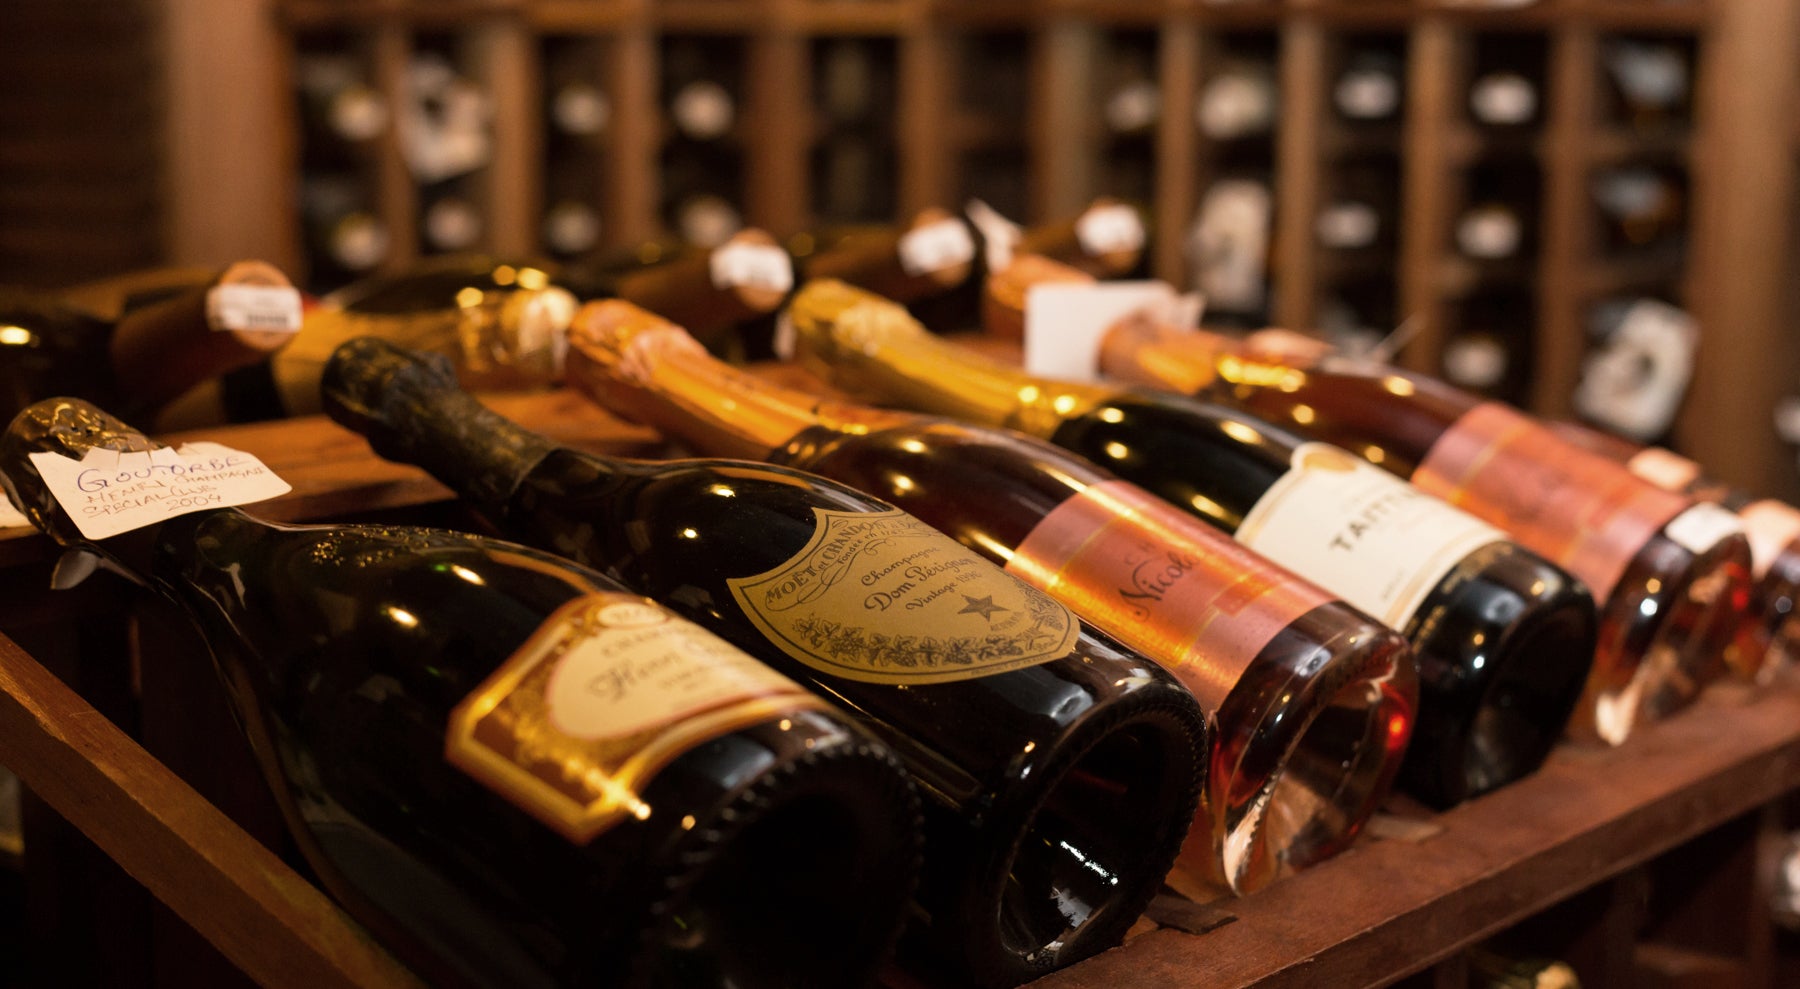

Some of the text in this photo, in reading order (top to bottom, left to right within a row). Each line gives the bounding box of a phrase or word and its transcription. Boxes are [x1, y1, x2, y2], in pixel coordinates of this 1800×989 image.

[77, 455, 249, 493] GOUTORBE
[83, 490, 169, 518] SPECIAL
[167, 493, 221, 512] 2004
[864, 558, 978, 612] Dom Pérignon
[905, 581, 958, 610] Vintage
